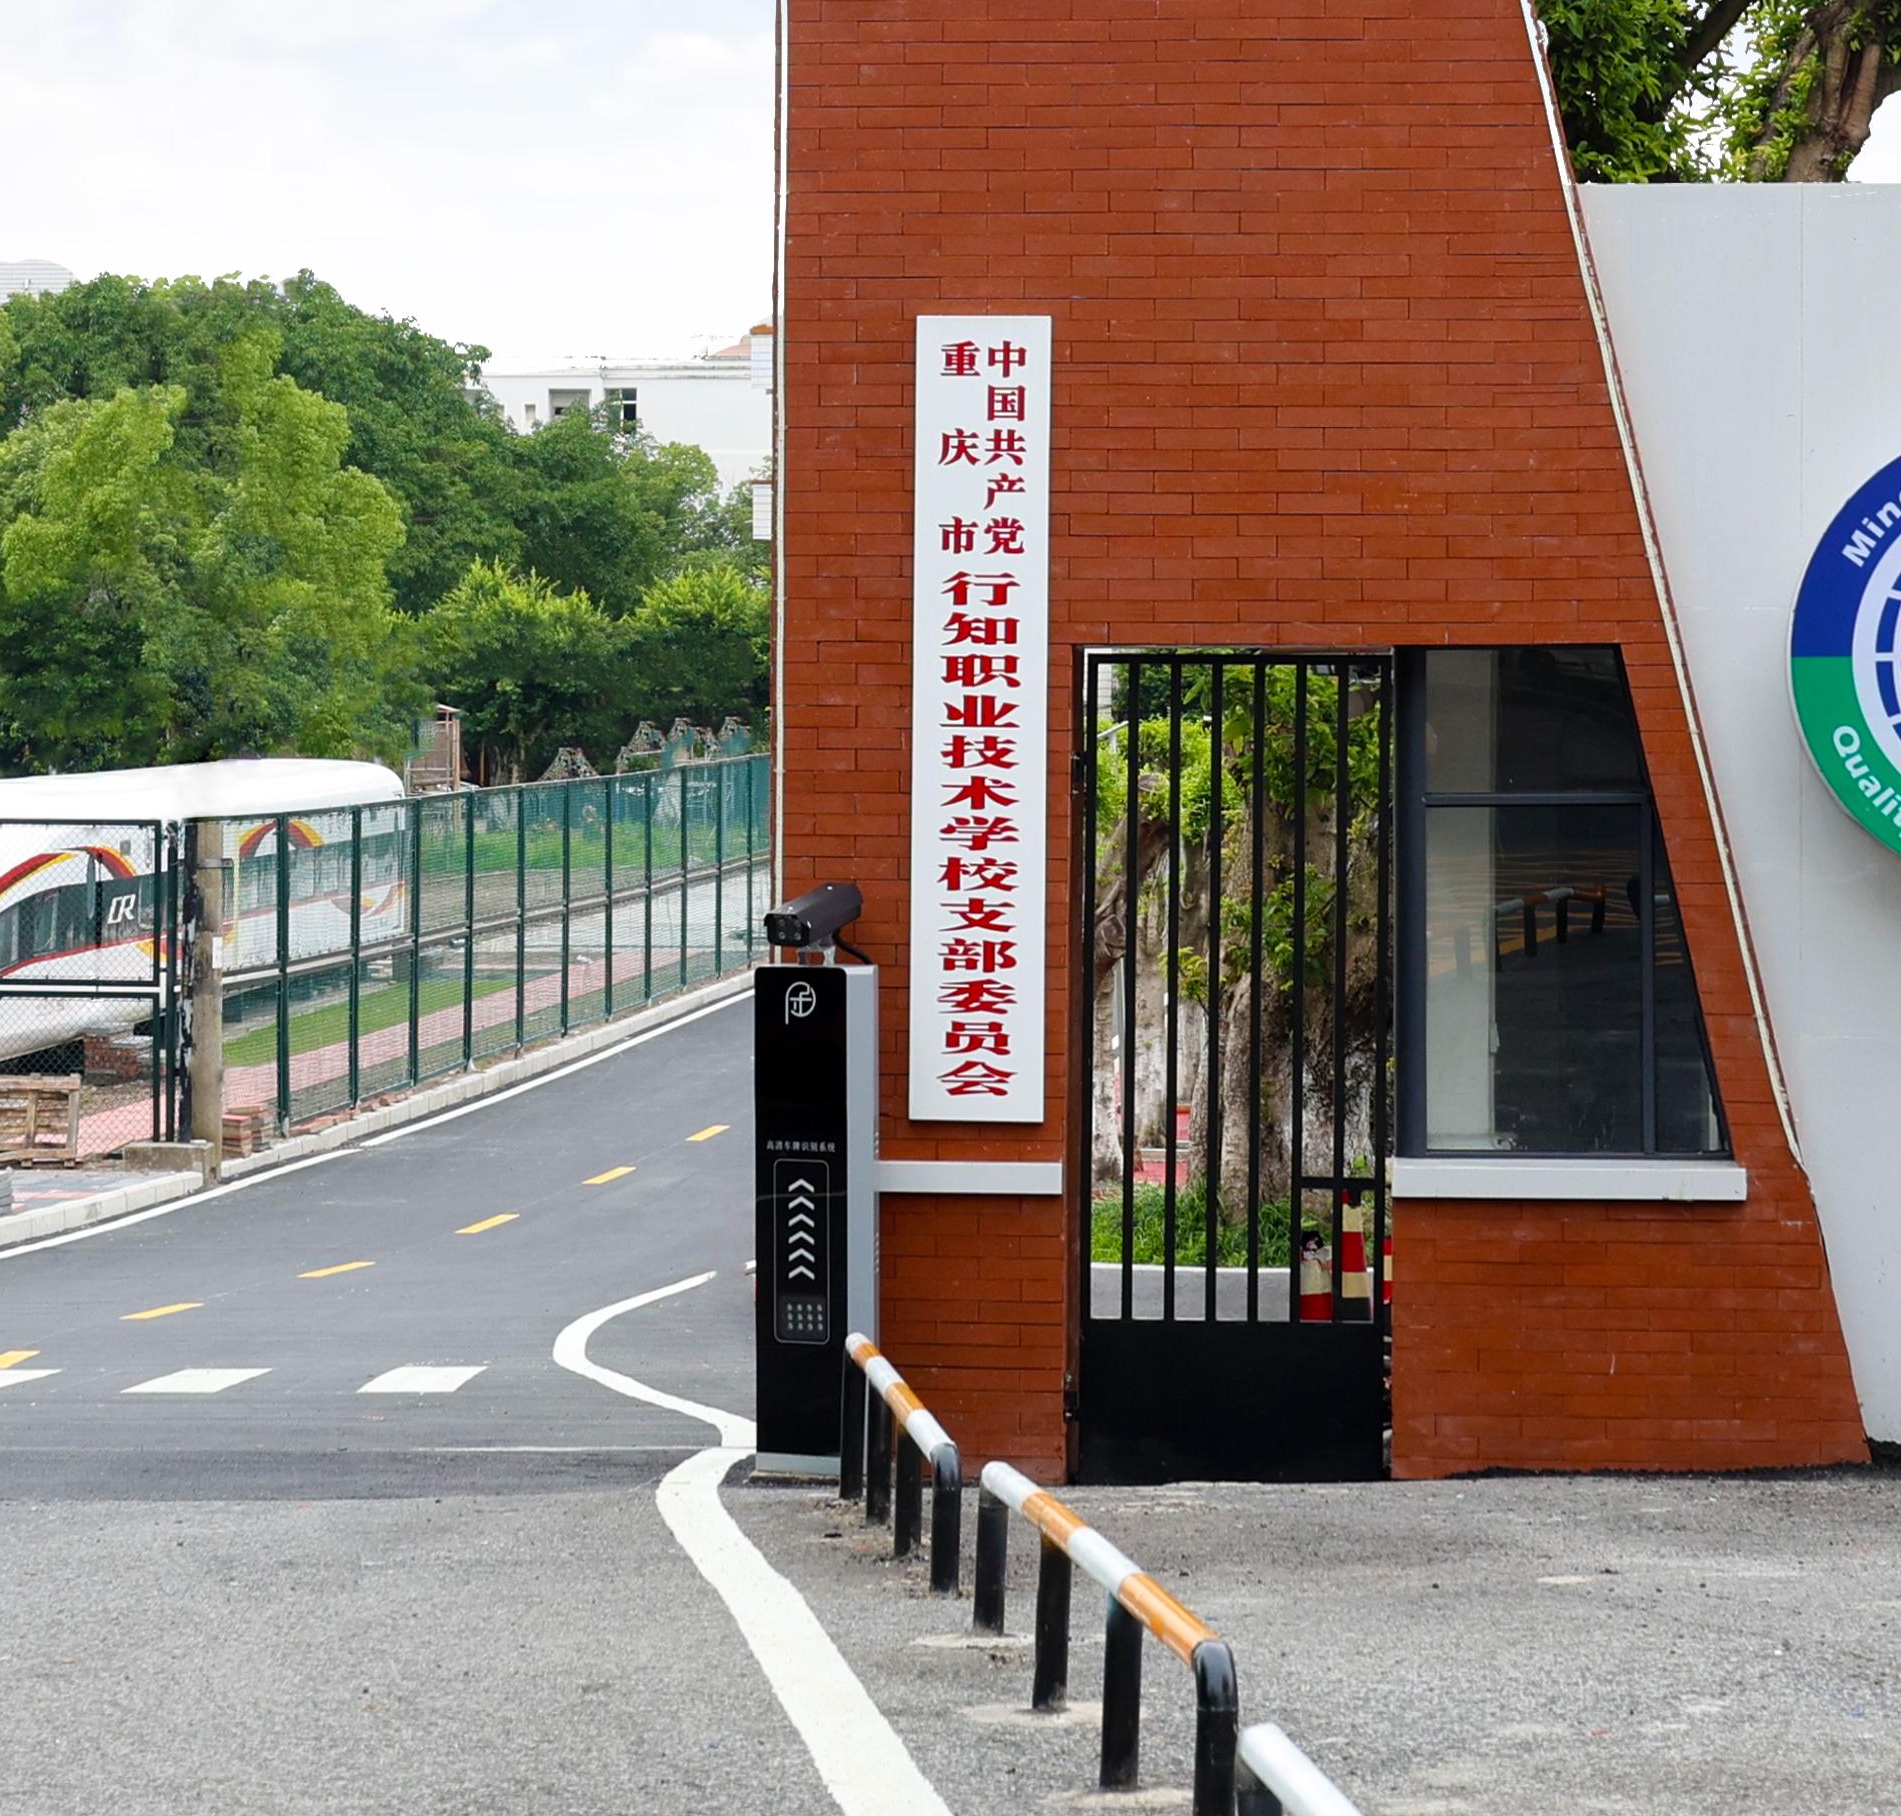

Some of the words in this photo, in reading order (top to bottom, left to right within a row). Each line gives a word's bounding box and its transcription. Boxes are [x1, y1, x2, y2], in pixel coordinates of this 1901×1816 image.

[939, 341, 980, 555] 重庆市
[984, 341, 1027, 556] 中国共产党
[937, 571, 1021, 1098] 行知职业技术学校支部委员会
